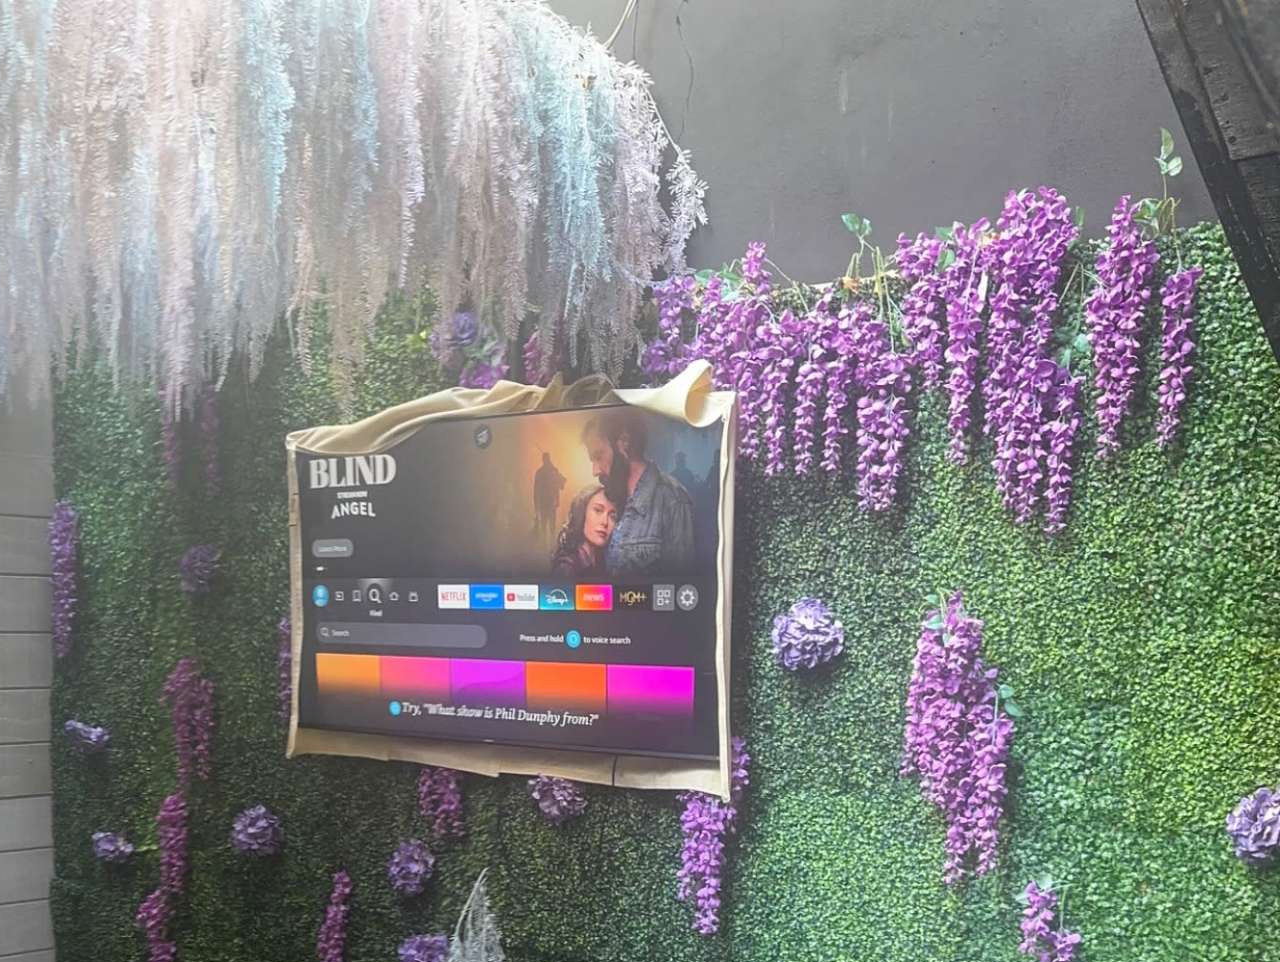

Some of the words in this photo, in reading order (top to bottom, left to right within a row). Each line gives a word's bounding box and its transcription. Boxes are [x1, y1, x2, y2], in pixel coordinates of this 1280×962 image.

[309, 453, 397, 489] BLIND
[331, 501, 377, 519] ANGEL
[440, 591, 467, 602] NETFLIX
[619, 592, 648, 606] MGM+
[519, 634, 536, 642] Press
[537, 634, 548, 643] and
[549, 635, 564, 643] hold
[583, 636, 591, 644] to
[609, 637, 631, 645] search
[401, 702, 422, 716] Try,
[456, 705, 483, 718] show
[484, 706, 494, 719] is
[495, 707, 516, 721] Phil
[517, 708, 560, 726] Dunphy
[560, 711, 599, 727] from?"
